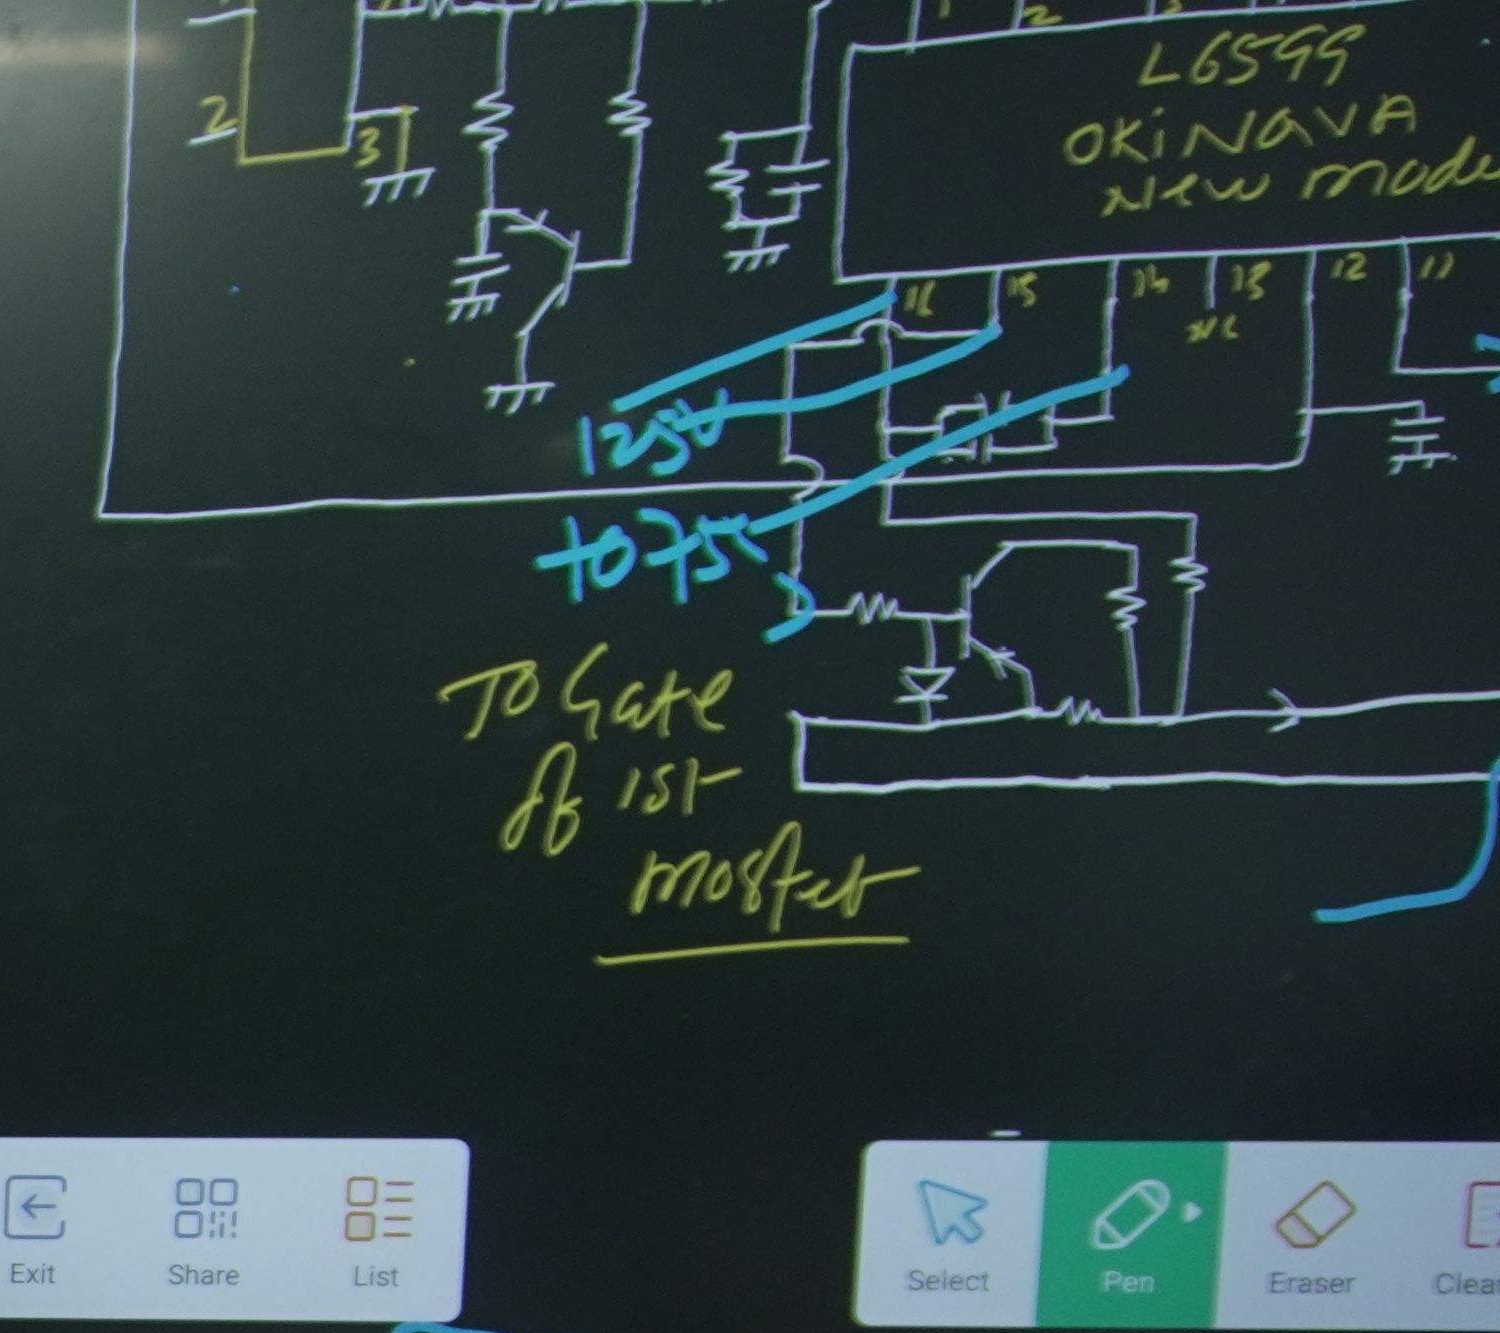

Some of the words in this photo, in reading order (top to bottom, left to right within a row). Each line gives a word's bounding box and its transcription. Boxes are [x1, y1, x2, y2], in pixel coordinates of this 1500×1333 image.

[1331, 250, 1368, 282] 12
[10, 1263, 55, 1285] Exit
[168, 1265, 240, 1286] Share
[354, 1267, 399, 1288] List
[907, 1269, 990, 1292] Select
[1103, 1271, 1155, 1294] Pen
[1269, 1272, 1356, 1295] Eraser
[1435, 1271, 1500, 1295] Clea
